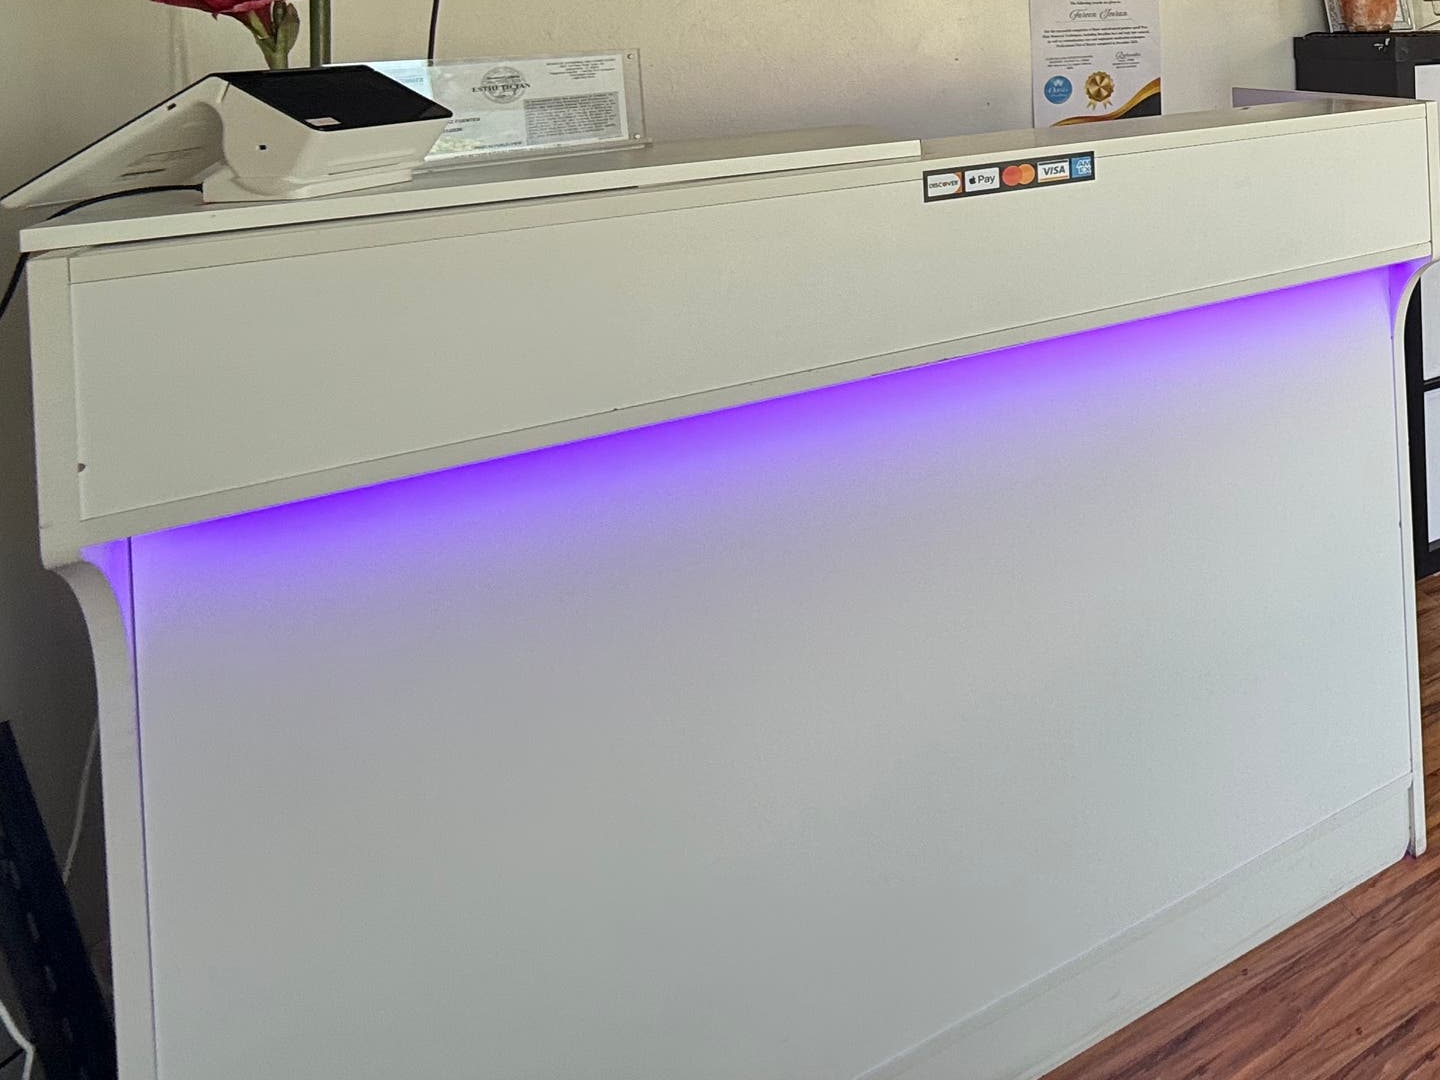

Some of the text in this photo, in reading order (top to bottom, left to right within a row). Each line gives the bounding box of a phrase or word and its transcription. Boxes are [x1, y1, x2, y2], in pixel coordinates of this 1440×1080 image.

[1042, 165, 1066, 176] VISA
[928, 179, 959, 190] DISCOVER
[978, 174, 996, 185] Pay
